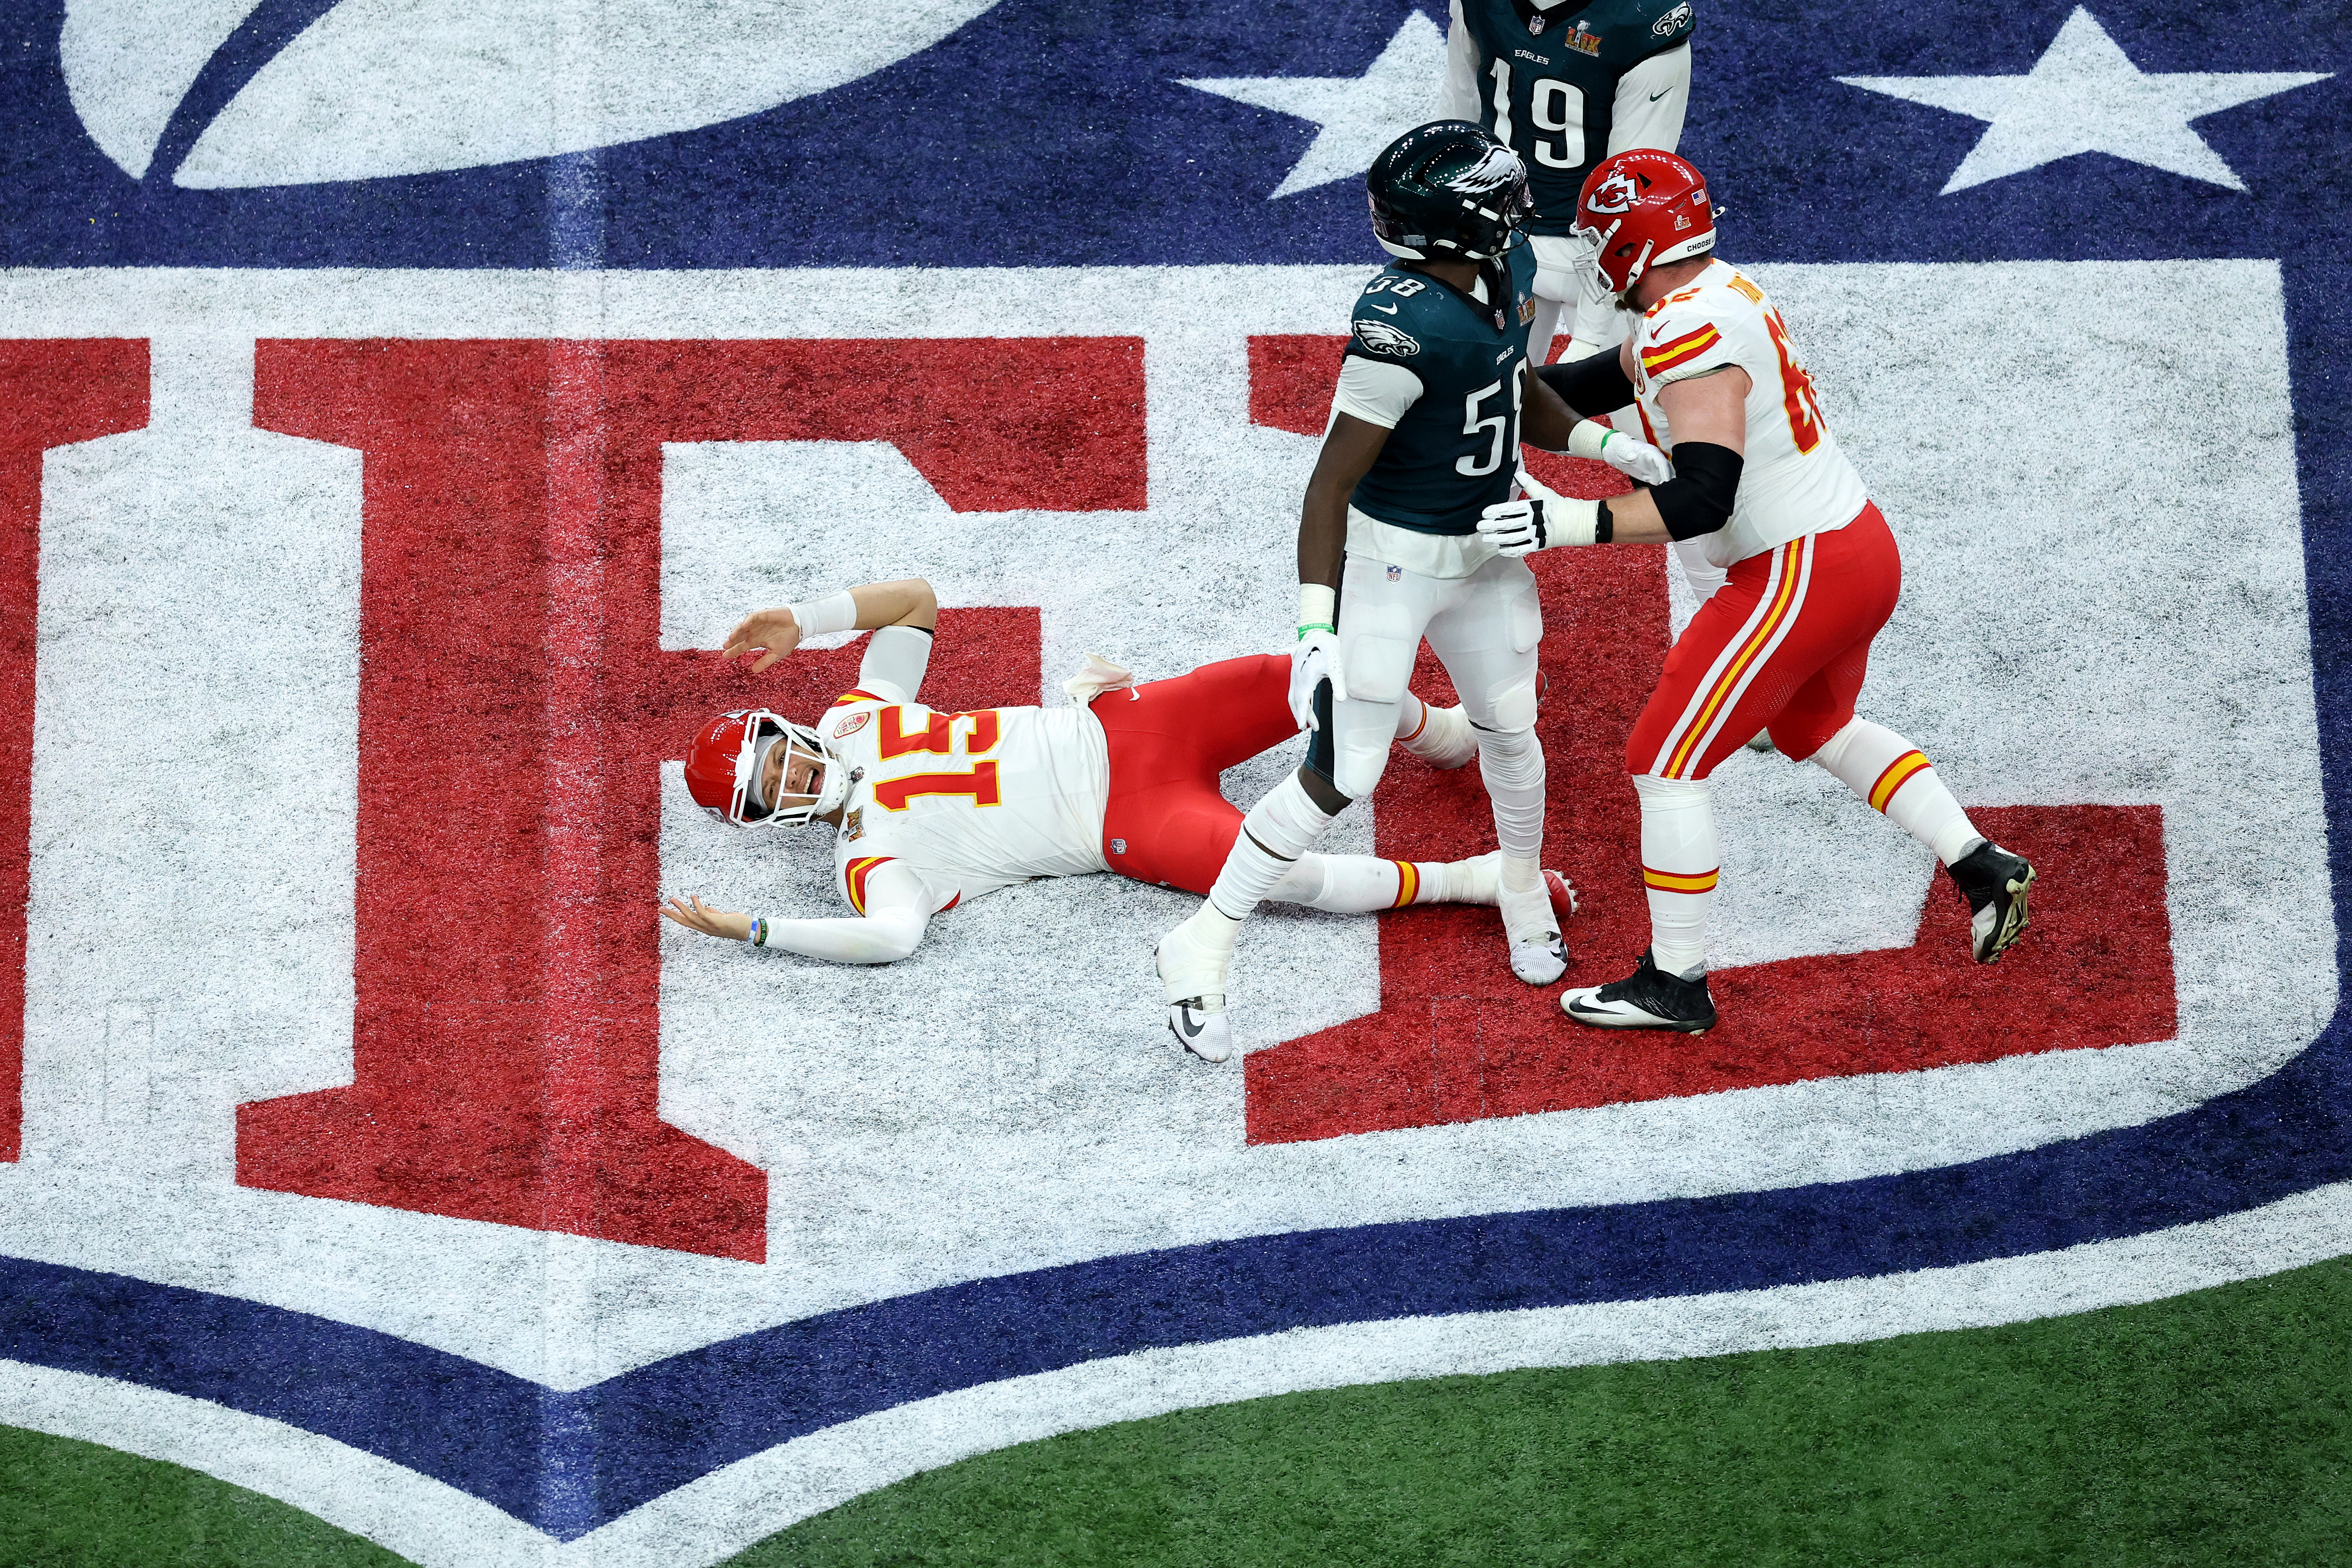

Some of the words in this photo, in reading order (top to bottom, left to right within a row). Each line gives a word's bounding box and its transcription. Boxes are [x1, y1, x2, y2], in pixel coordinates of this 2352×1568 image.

[1514, 49, 1550, 65] EAGLES
[1490, 56, 1586, 169] 19
[1687, 238, 1712, 252] CHOOSE
[1366, 276, 1426, 297] 58
[1496, 345, 1514, 366] EAGLES
[1763, 305, 1828, 456] 6
[873, 705, 1001, 812] 15
[0, 335, 2178, 1264] FL
